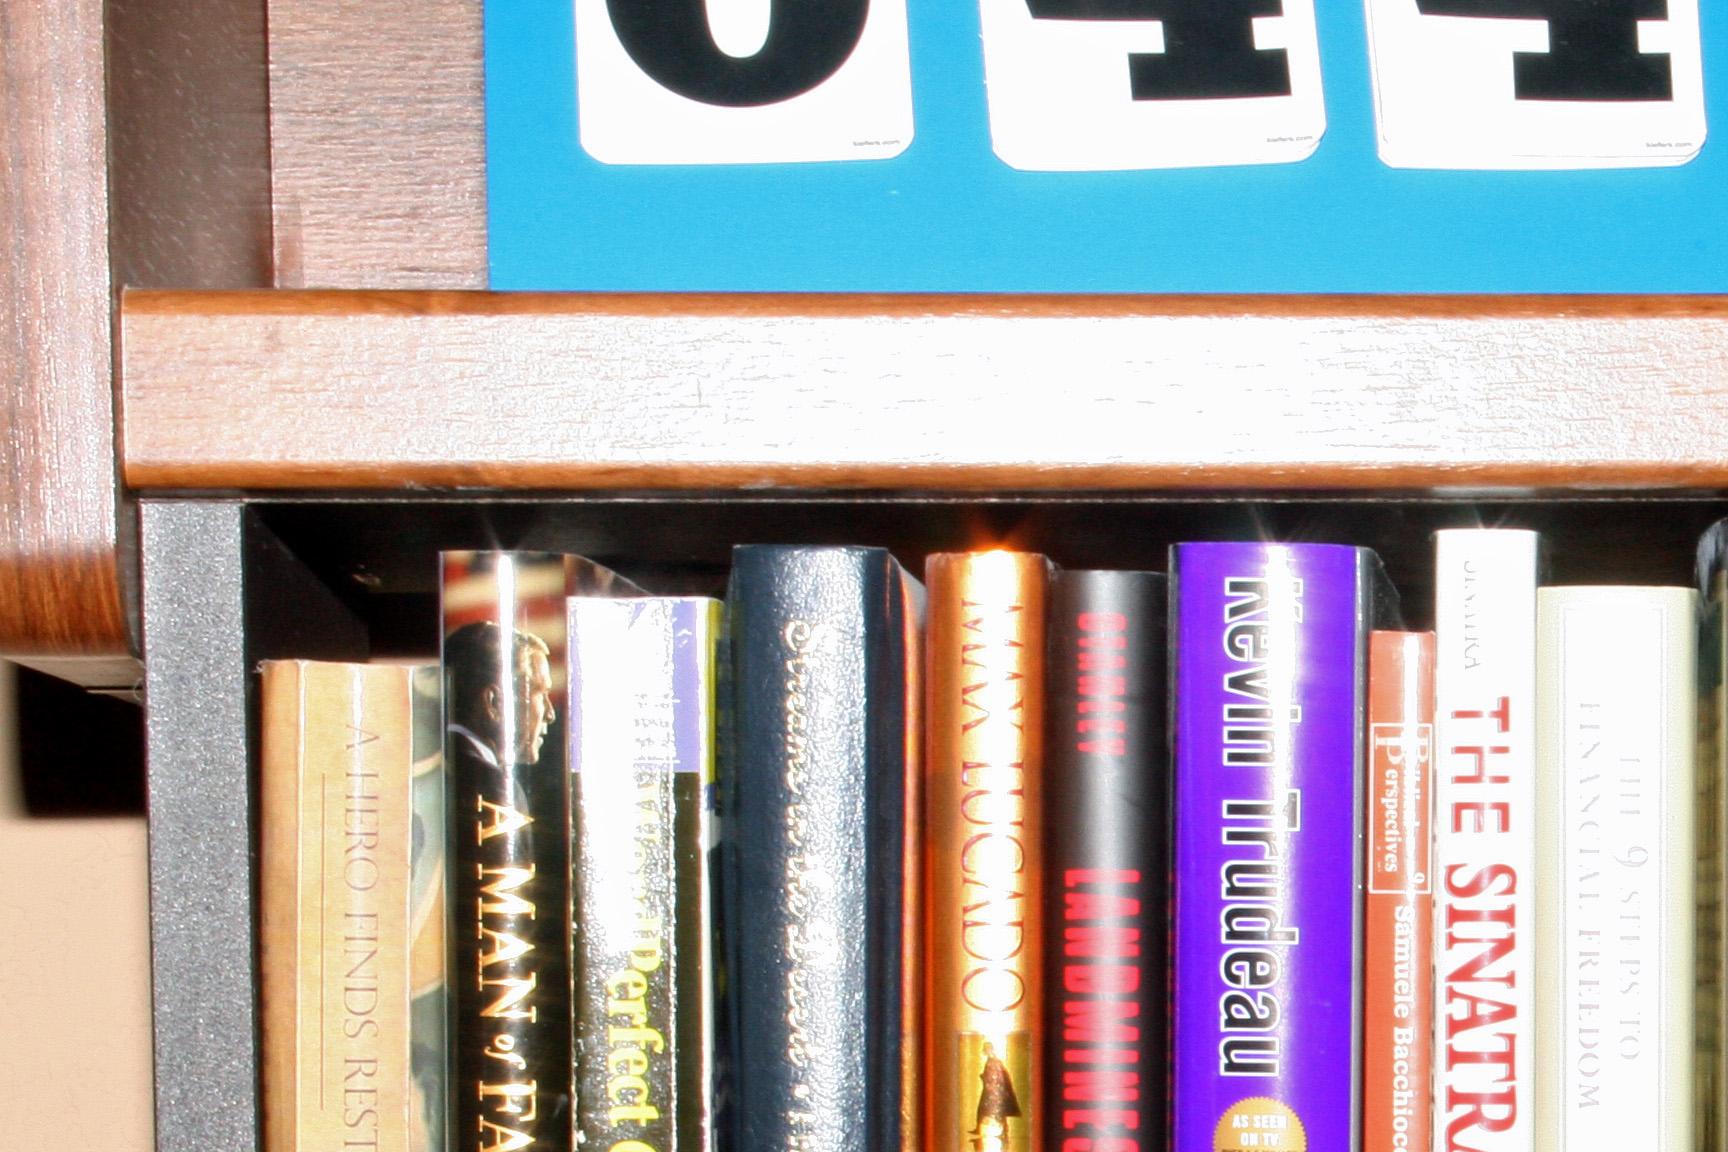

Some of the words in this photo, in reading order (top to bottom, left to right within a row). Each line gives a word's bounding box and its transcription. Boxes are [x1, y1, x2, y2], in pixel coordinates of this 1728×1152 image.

[962, 600, 1025, 736] MAX
[1077, 612, 1127, 757] STANLEY
[1222, 577, 1303, 767] Kevin
[344, 726, 381, 751] A
[1452, 696, 1510, 834] THE
[343, 771, 380, 892] HERO
[478, 795, 534, 846] A
[1613, 845, 1650, 868] 9
[478, 863, 536, 1023] MAN
[961, 761, 1026, 1012] LUCADO
[1219, 789, 1301, 1078] Trudeau
[343, 912, 380, 1039] FINDS
[1391, 905, 1415, 1019] Samuele
[1577, 929, 1601, 1110] FREEDOM
[483, 1034, 528, 1070] of
[1232, 1113, 1248, 1129] AS
[1252, 1113, 1287, 1129] SEEN
[1240, 1132, 1258, 1146] ON
[1262, 1132, 1280, 1146] TV
